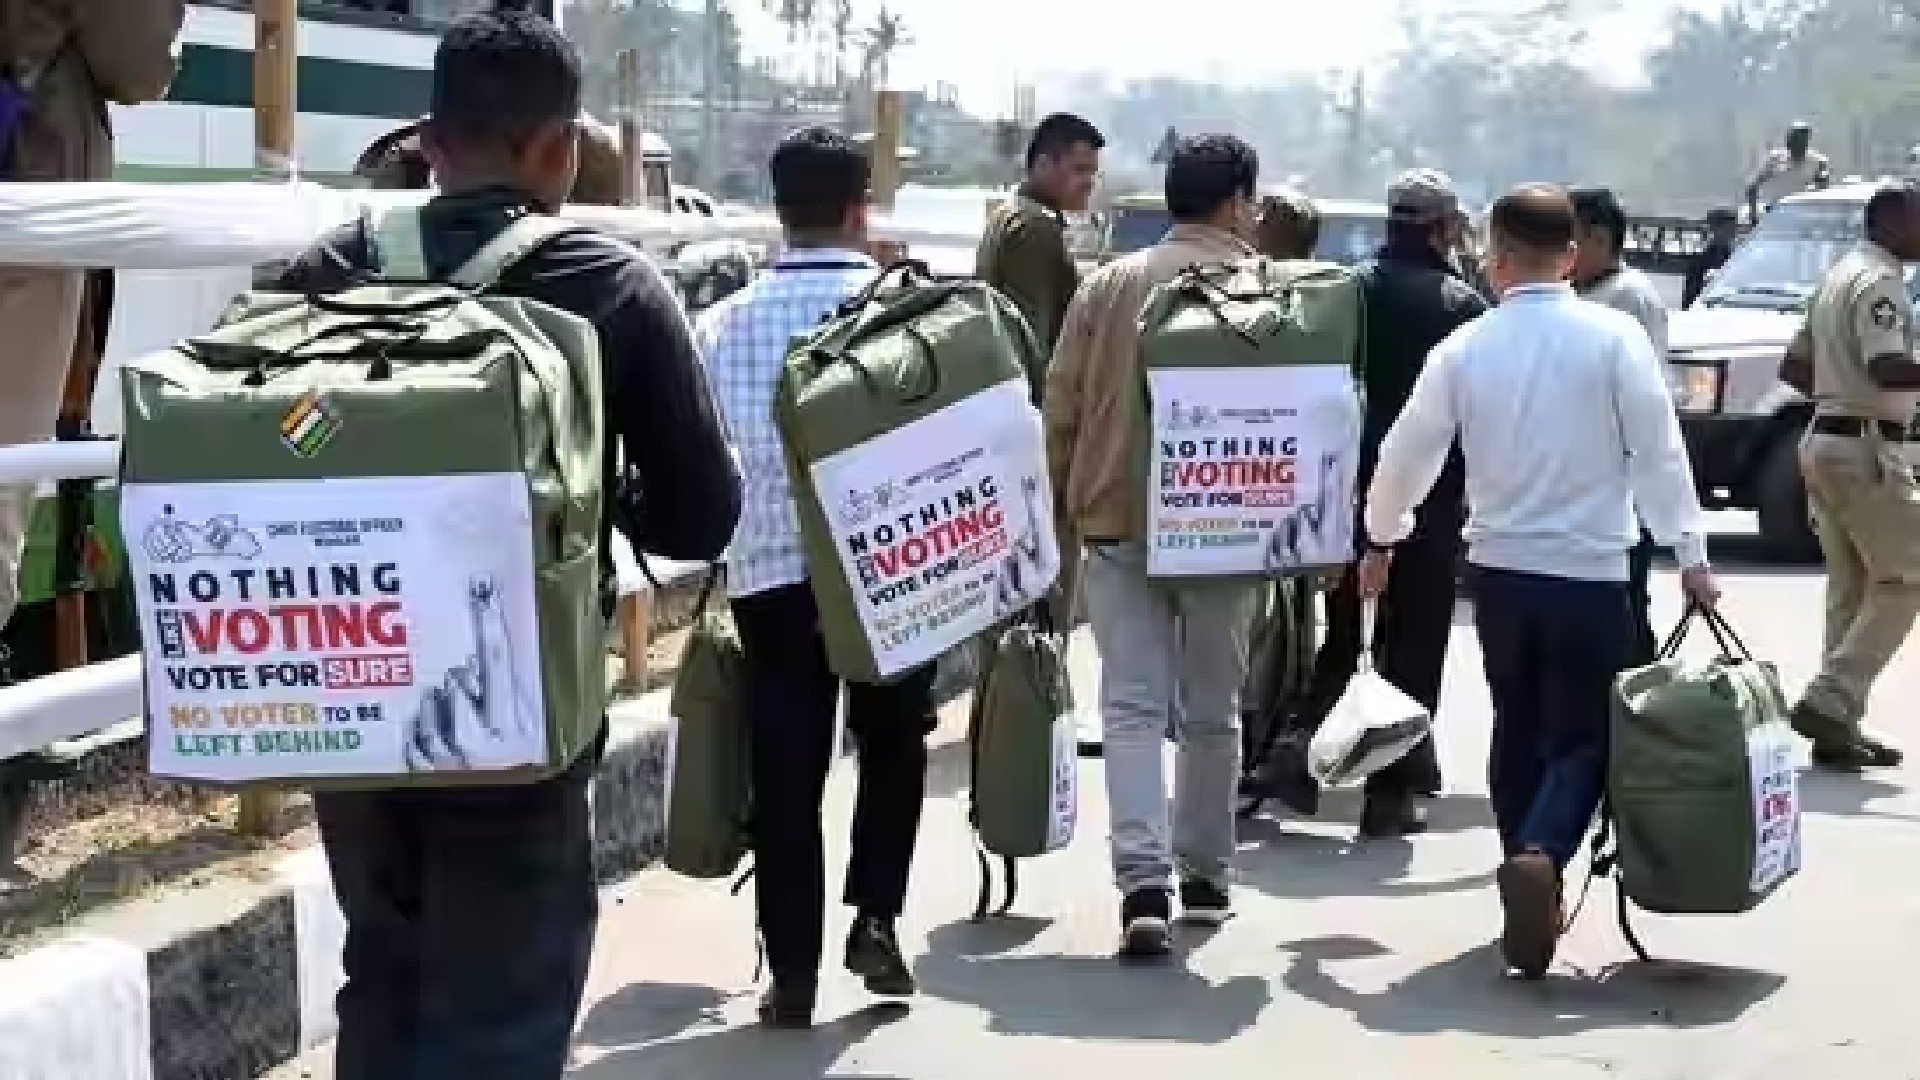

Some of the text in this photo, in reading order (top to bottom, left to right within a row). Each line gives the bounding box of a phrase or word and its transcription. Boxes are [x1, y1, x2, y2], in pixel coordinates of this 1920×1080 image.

[1160, 436, 1298, 458] NOTHING
[1174, 458, 1295, 487] VOTING
[846, 475, 998, 554] NOTHING
[1160, 492, 1204, 507] VOTE
[1206, 492, 1243, 507] FOR
[871, 499, 1002, 578] VOTING
[149, 561, 401, 603] NOTHING
[867, 557, 960, 606] VOTE FOR
[182, 601, 408, 655] VOTING
[167, 655, 413, 690] VOTE FOR SURE
[169, 702, 383, 730] NO VOTER TO BE
[173, 729, 362, 757] LEFT BEHIND
